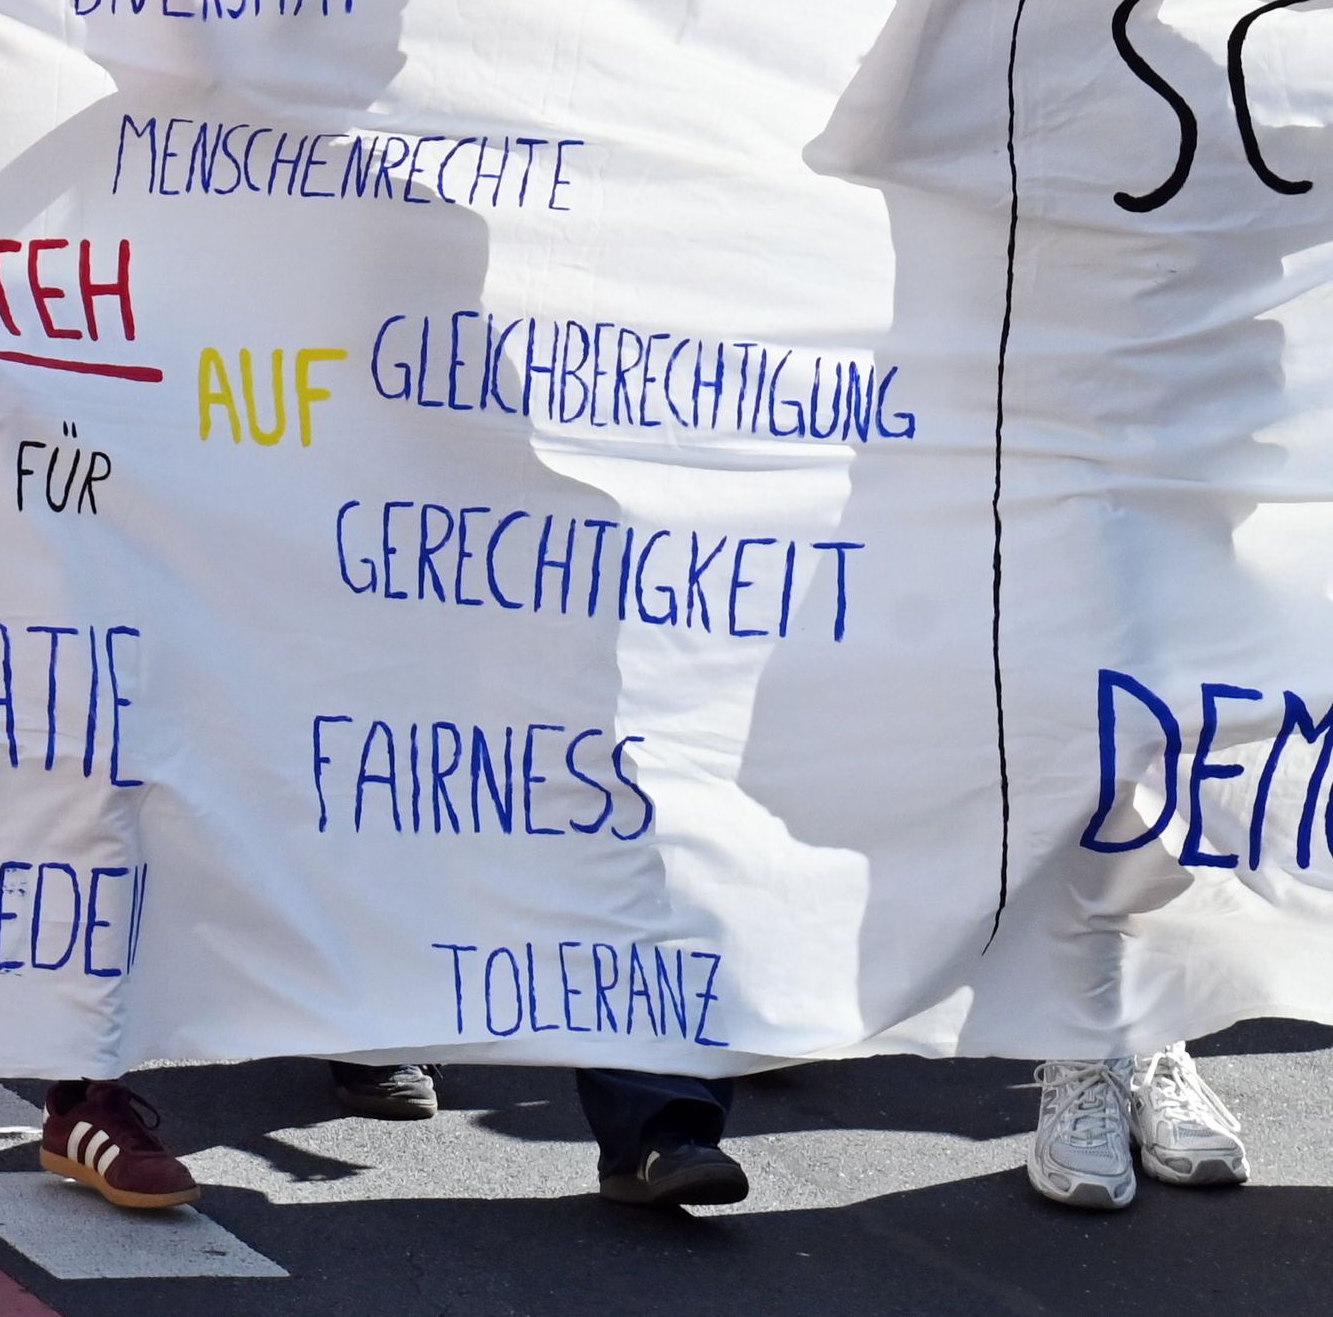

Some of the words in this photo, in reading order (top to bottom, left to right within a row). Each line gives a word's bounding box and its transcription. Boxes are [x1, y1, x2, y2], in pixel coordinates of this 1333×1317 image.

[112, 114, 585, 212] MENSCHENRECHTE
[199, 347, 348, 447] AUF
[370, 310, 916, 443] GLEICHBERECHTIGUNG
[17, 420, 112, 514] FÜR
[336, 500, 866, 642] GERECHTIGKEIT
[312, 715, 654, 840] FAIRNESS
[1079, 668, 1333, 871] DEM
[431, 942, 729, 1046] TOLERANZ
